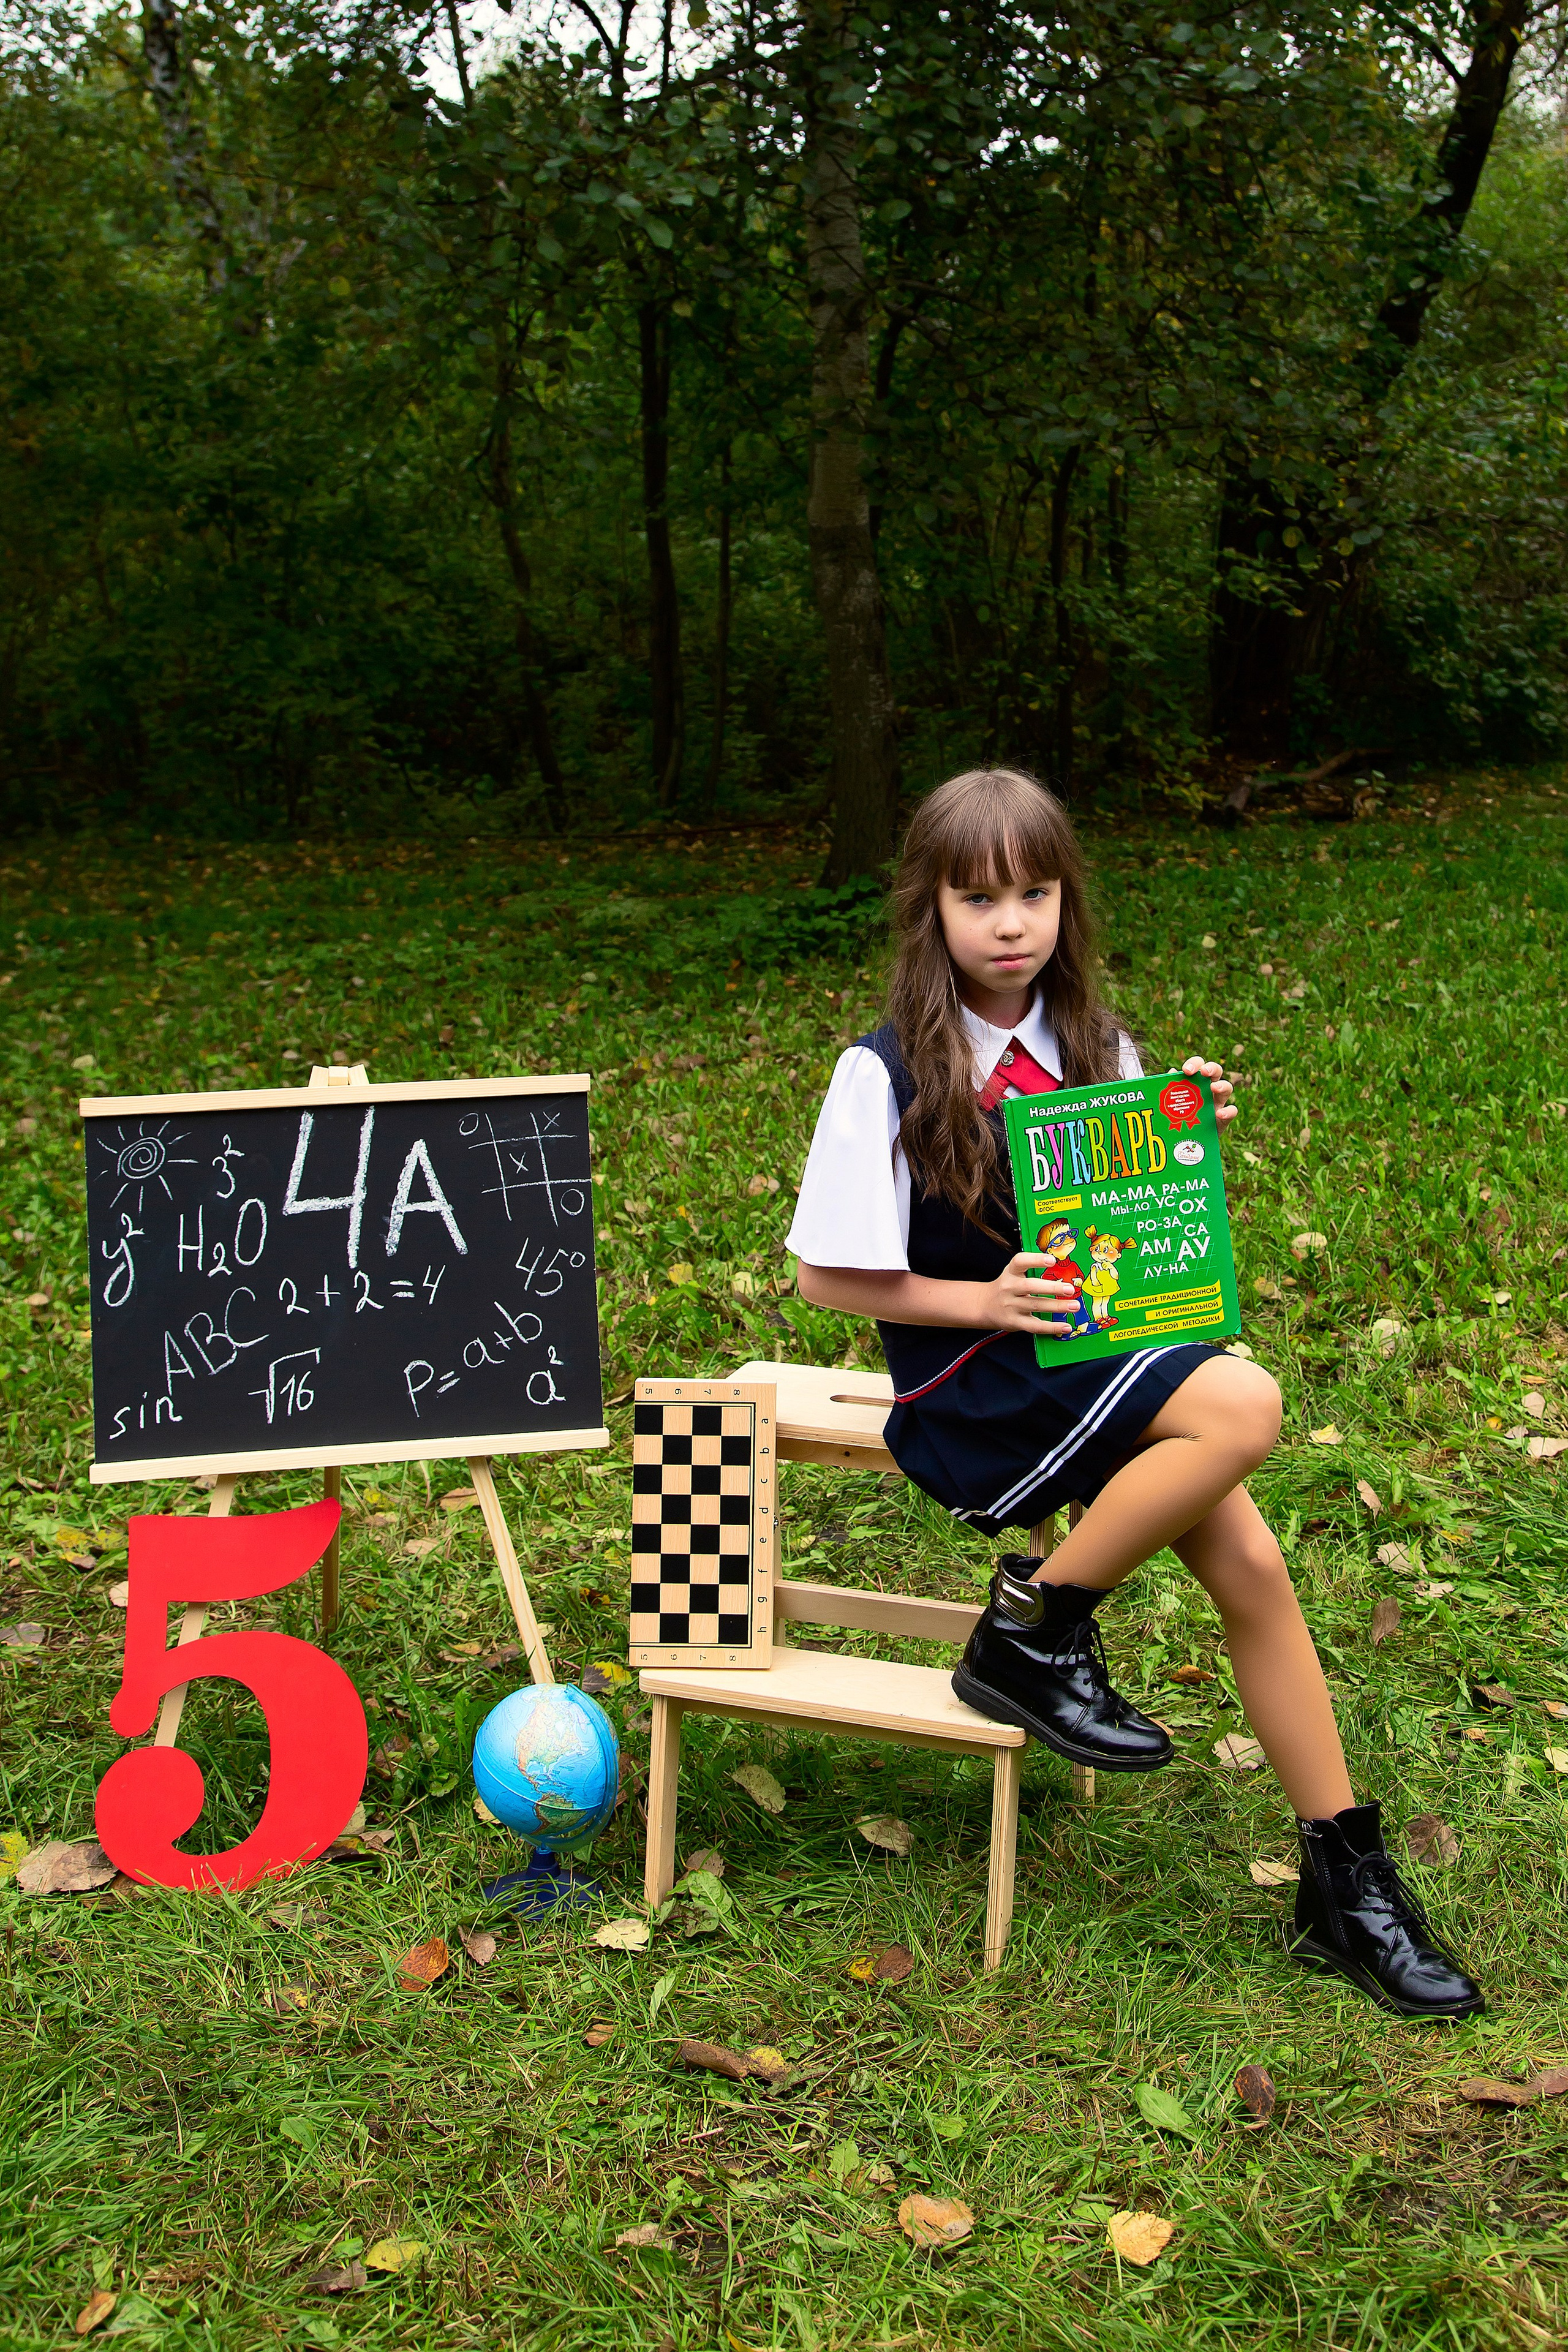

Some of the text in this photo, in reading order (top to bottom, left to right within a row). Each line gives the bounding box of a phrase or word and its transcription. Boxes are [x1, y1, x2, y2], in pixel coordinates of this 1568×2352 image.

[1029, 1091, 1145, 1117] Надежда ЖУКОВА
[1024, 1109, 1166, 1193] БУКВАРЬ
[1038, 1196, 1078, 1207] Соответствует
[1091, 1178, 1210, 1207] МА-МА РА-МА
[1110, 1196, 1208, 1216] МЫ-ЛО УС ОХ
[1137, 1215, 1208, 1237] РО-ЗА СА
[1139, 1236, 1211, 1261] АМ АУ
[1144, 1261, 1189, 1278] ЛУ-НА
[1118, 1286, 1216, 1308] СОЧЕТАНИЕ ТРАДИЦИОННОЙ
[1163, 1300, 1218, 1316] ОРИГИНАЛЬНОЙ
[1114, 1316, 1220, 1338] ЛОГОПЕДИЧЕСКОЙ МЕТОДИКИ
[95, 1497, 368, 1894] 5
